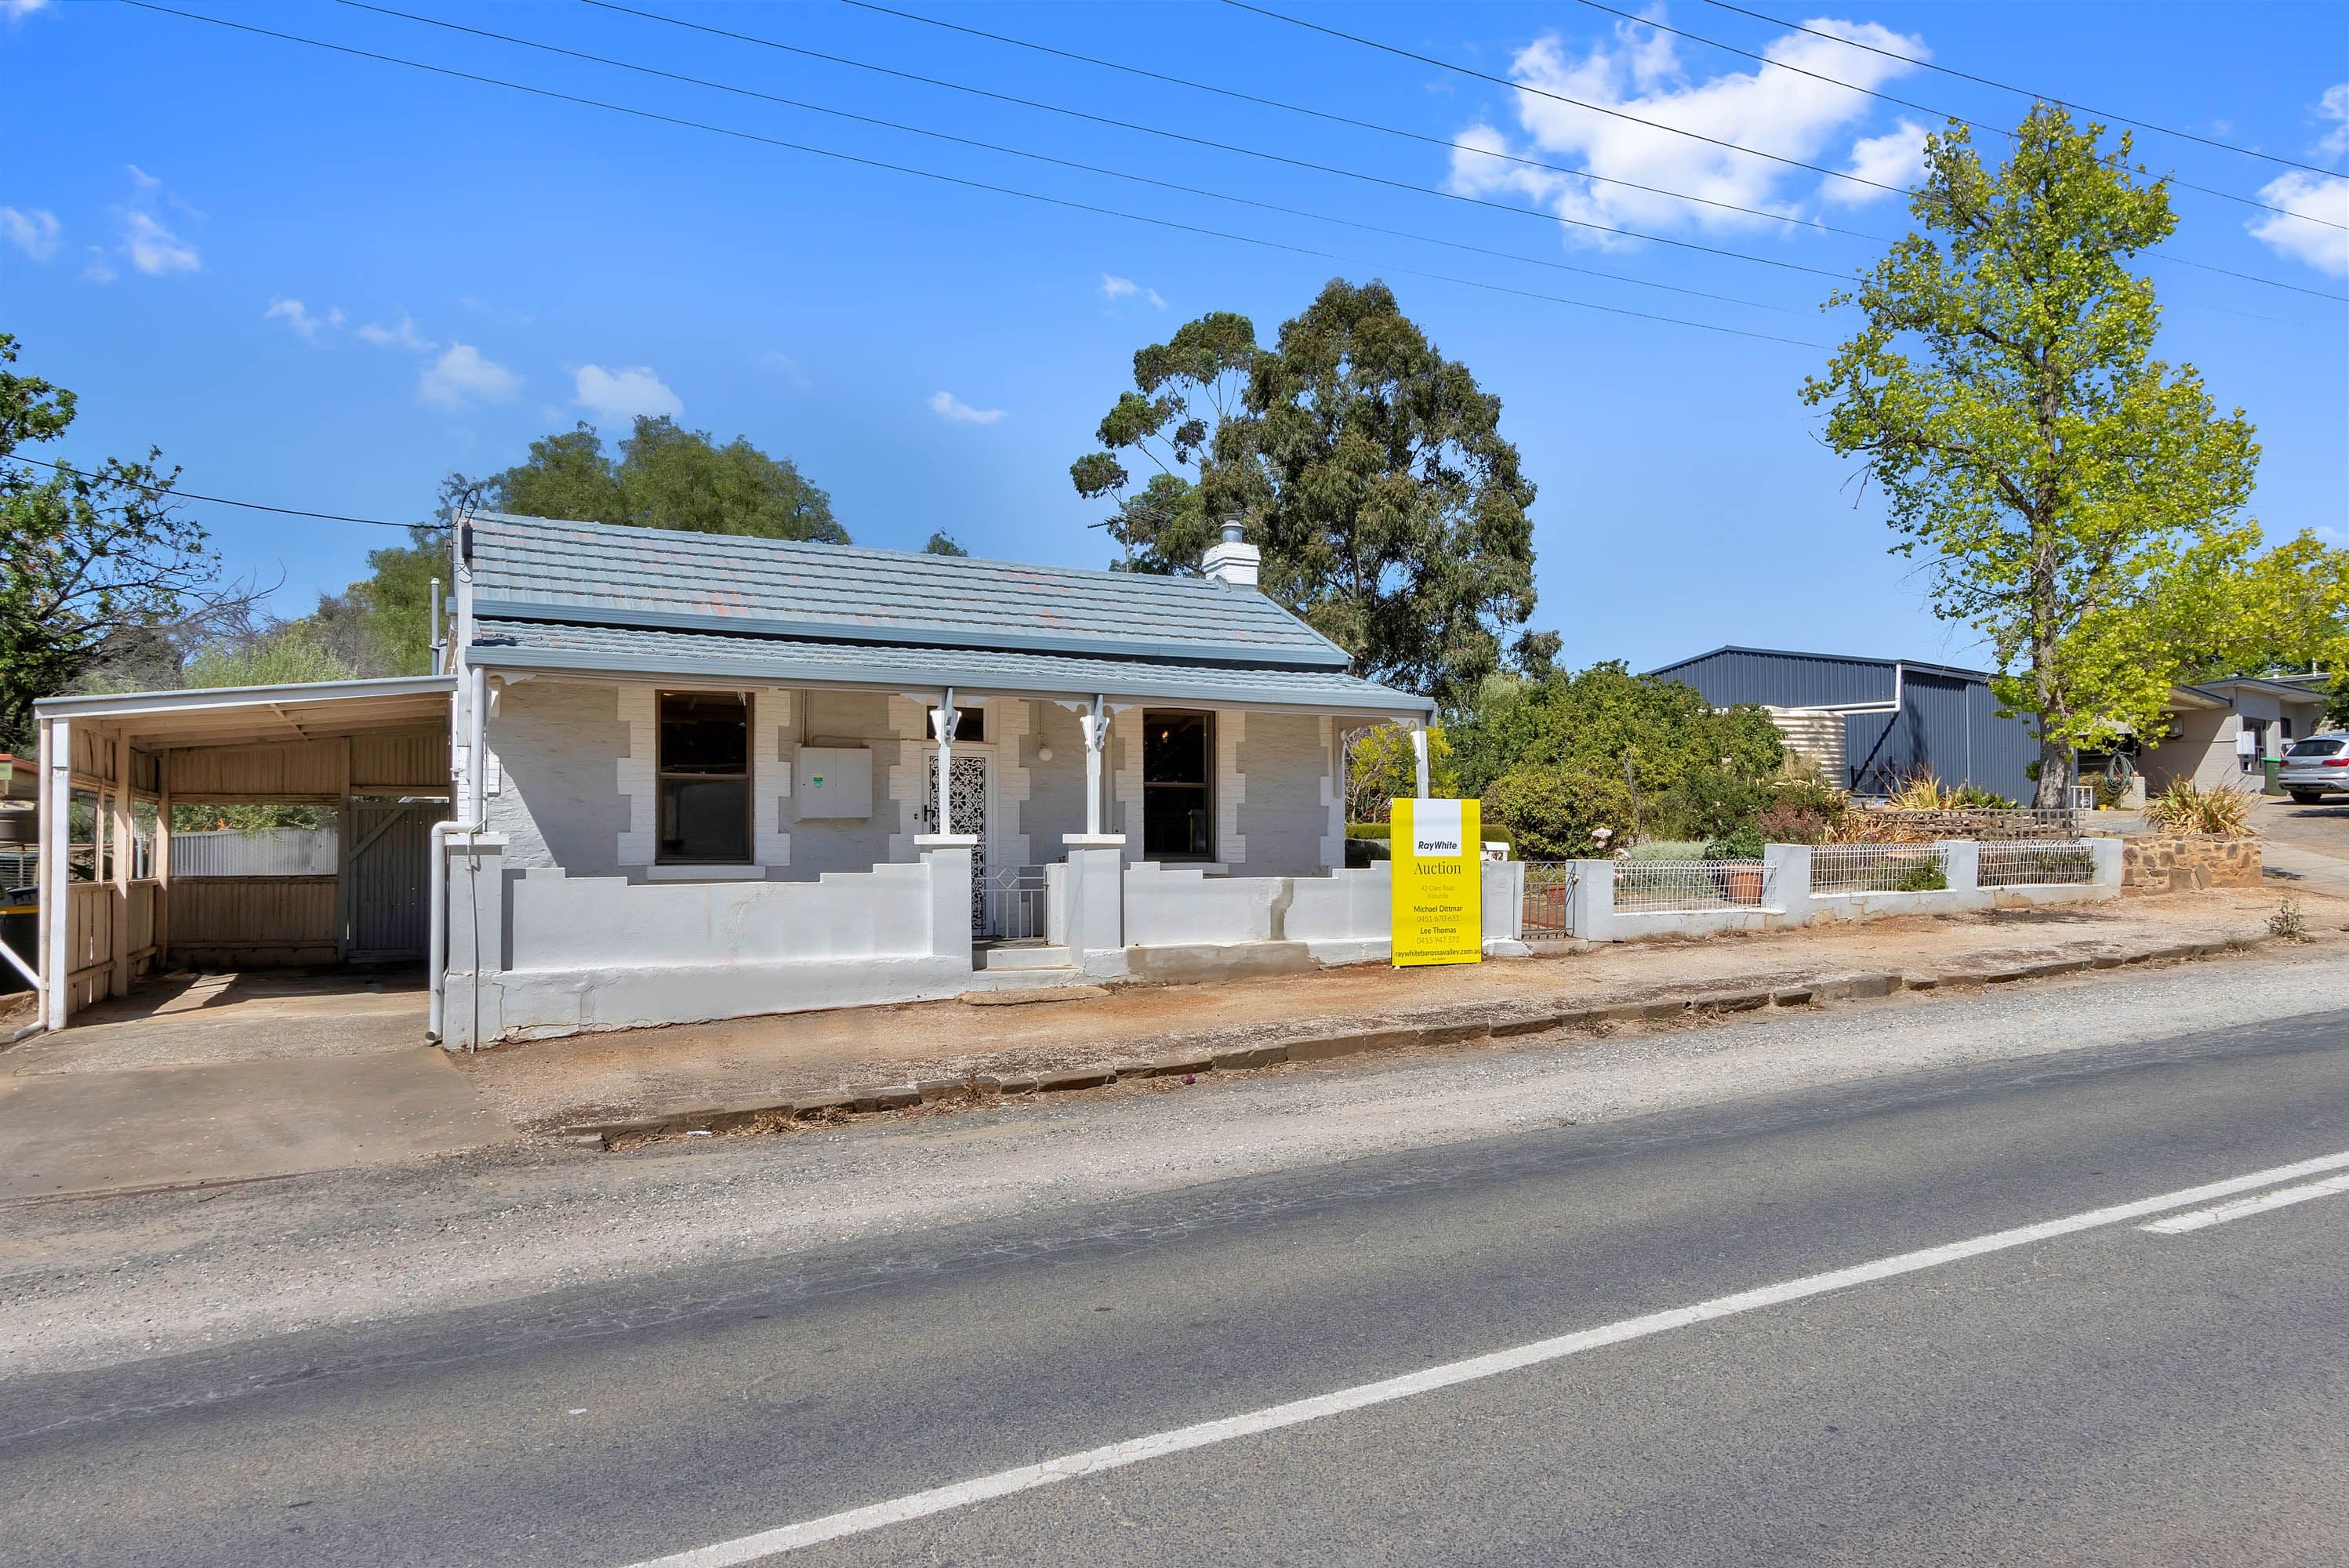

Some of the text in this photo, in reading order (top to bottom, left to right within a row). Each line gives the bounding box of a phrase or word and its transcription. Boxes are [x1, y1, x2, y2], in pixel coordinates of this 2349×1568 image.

[1492, 851, 1504, 861] 42
[1414, 861, 1461, 875] Auction
[1395, 948, 1481, 958] raywhitebarossavalley.com.au
